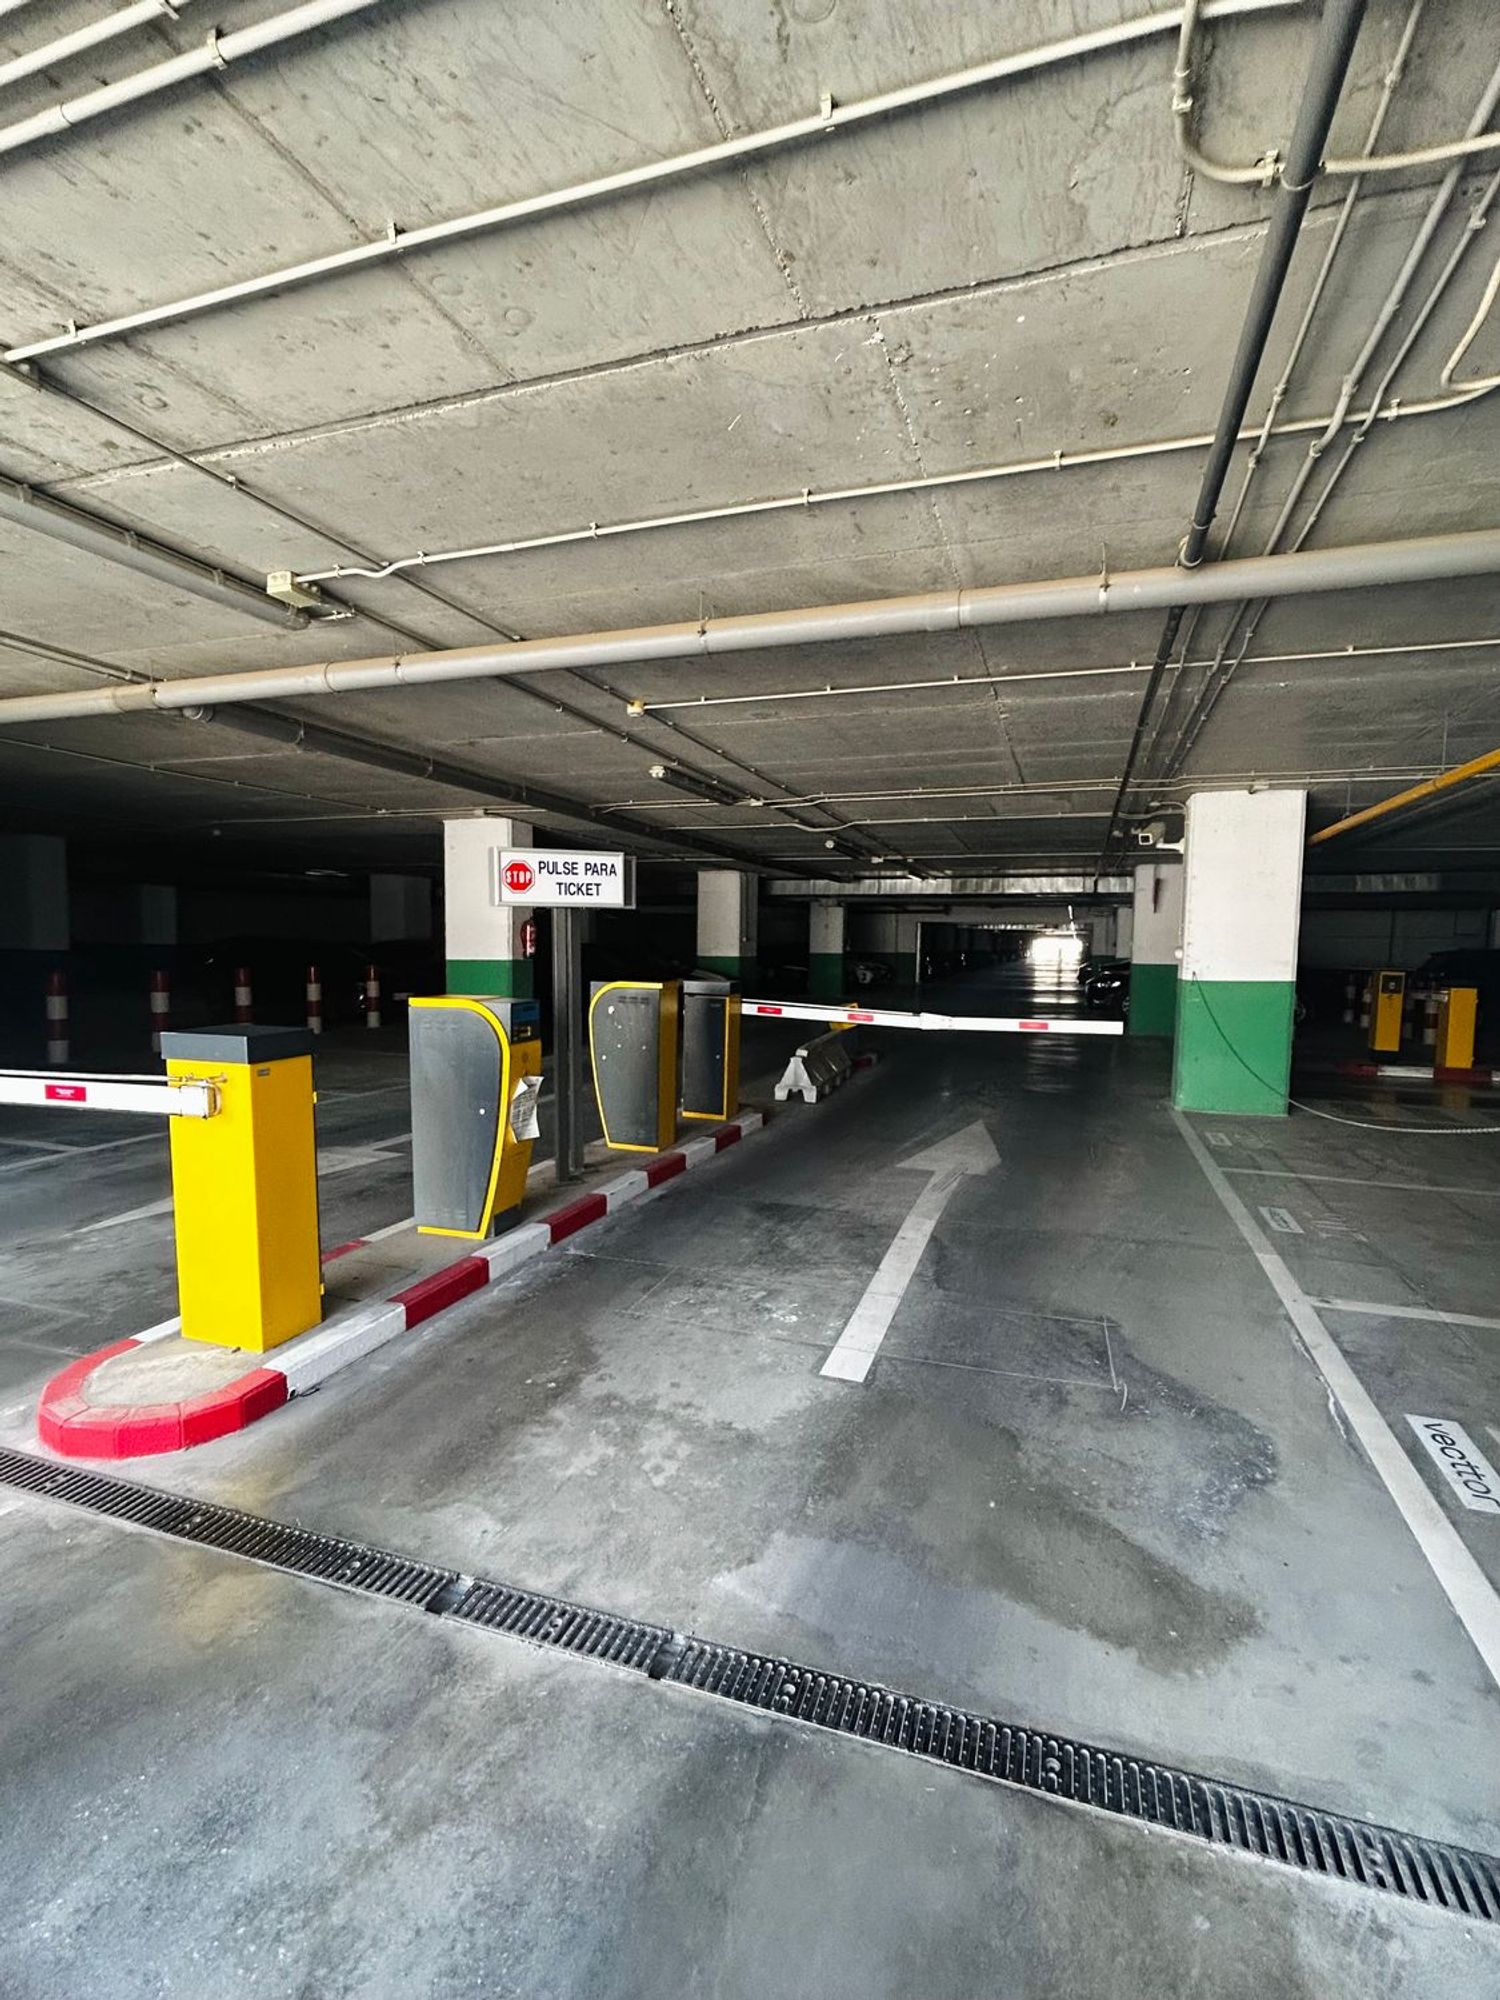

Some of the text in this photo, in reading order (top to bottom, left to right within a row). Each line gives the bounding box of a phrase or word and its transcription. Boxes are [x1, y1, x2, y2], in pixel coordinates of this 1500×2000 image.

[538, 860, 617, 876] PULSE PARA
[505, 870, 531, 883] STOP
[556, 882, 601, 896] TICKET
